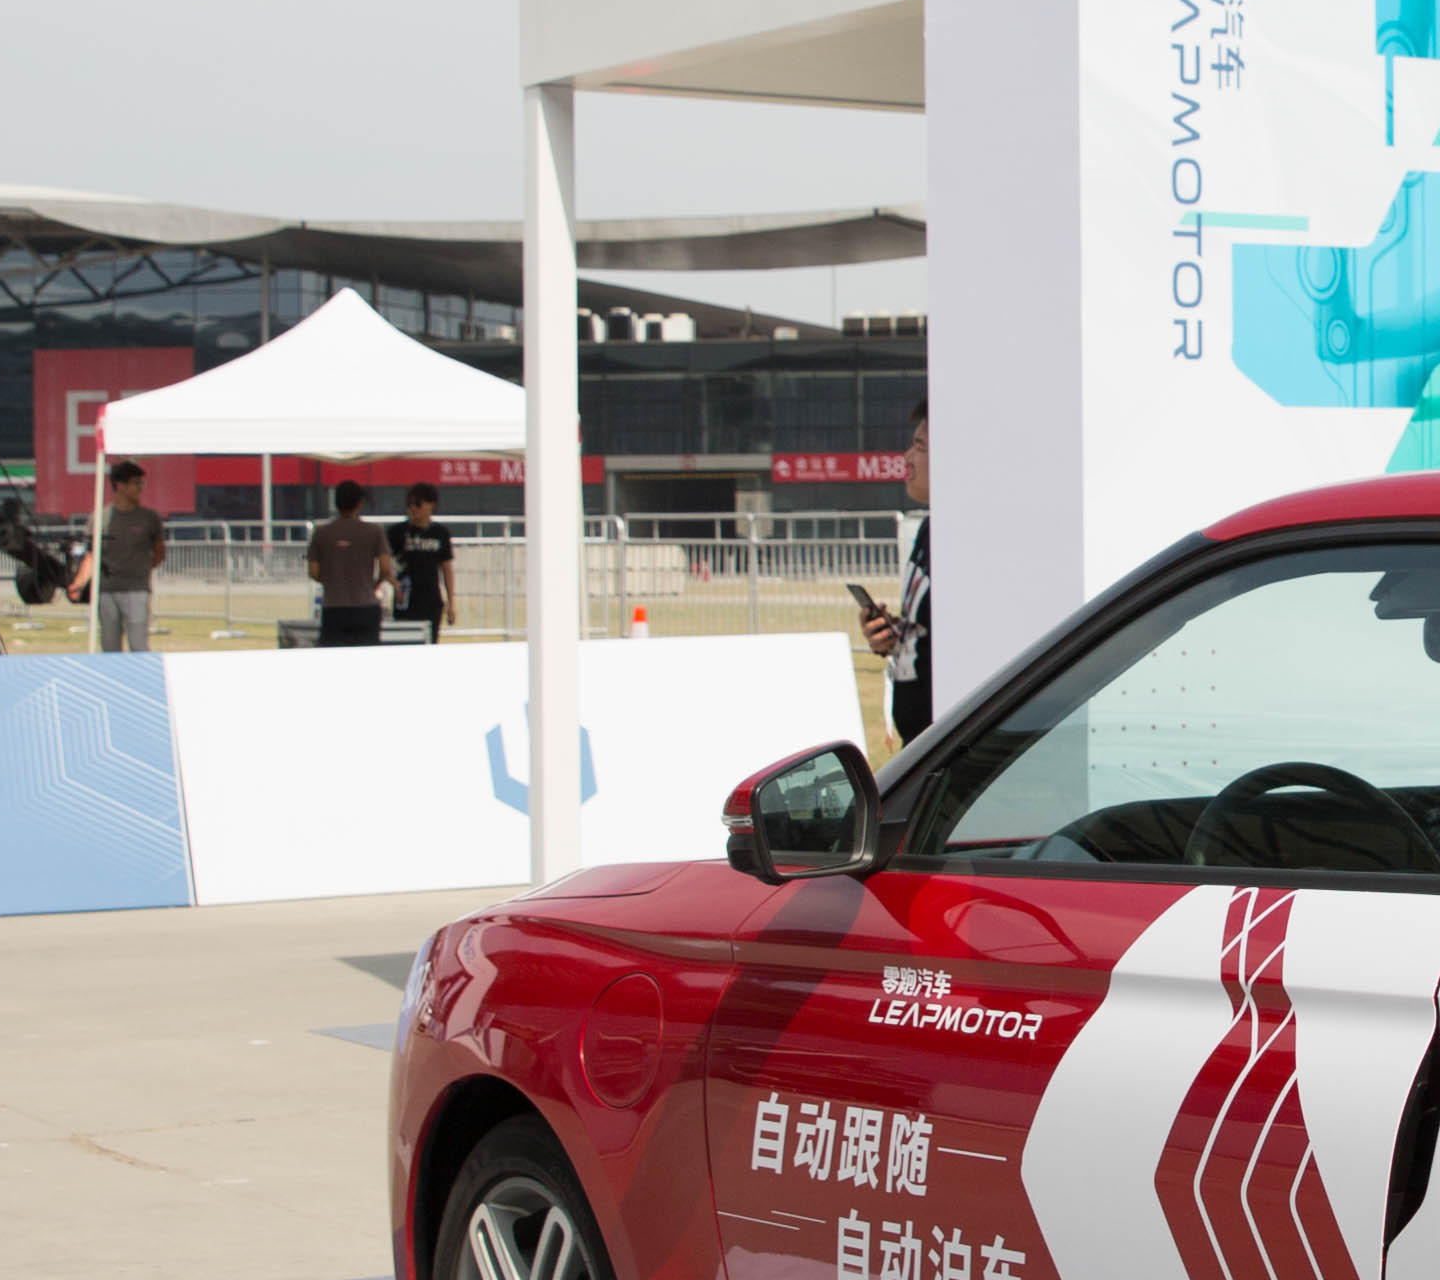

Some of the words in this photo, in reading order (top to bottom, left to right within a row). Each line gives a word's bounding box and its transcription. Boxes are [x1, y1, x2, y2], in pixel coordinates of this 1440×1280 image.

[880, 965, 953, 999] 零跑汽车
[868, 998, 1044, 1041] LEAPMOTOR
[750, 1091, 934, 1197] 自动跟随
